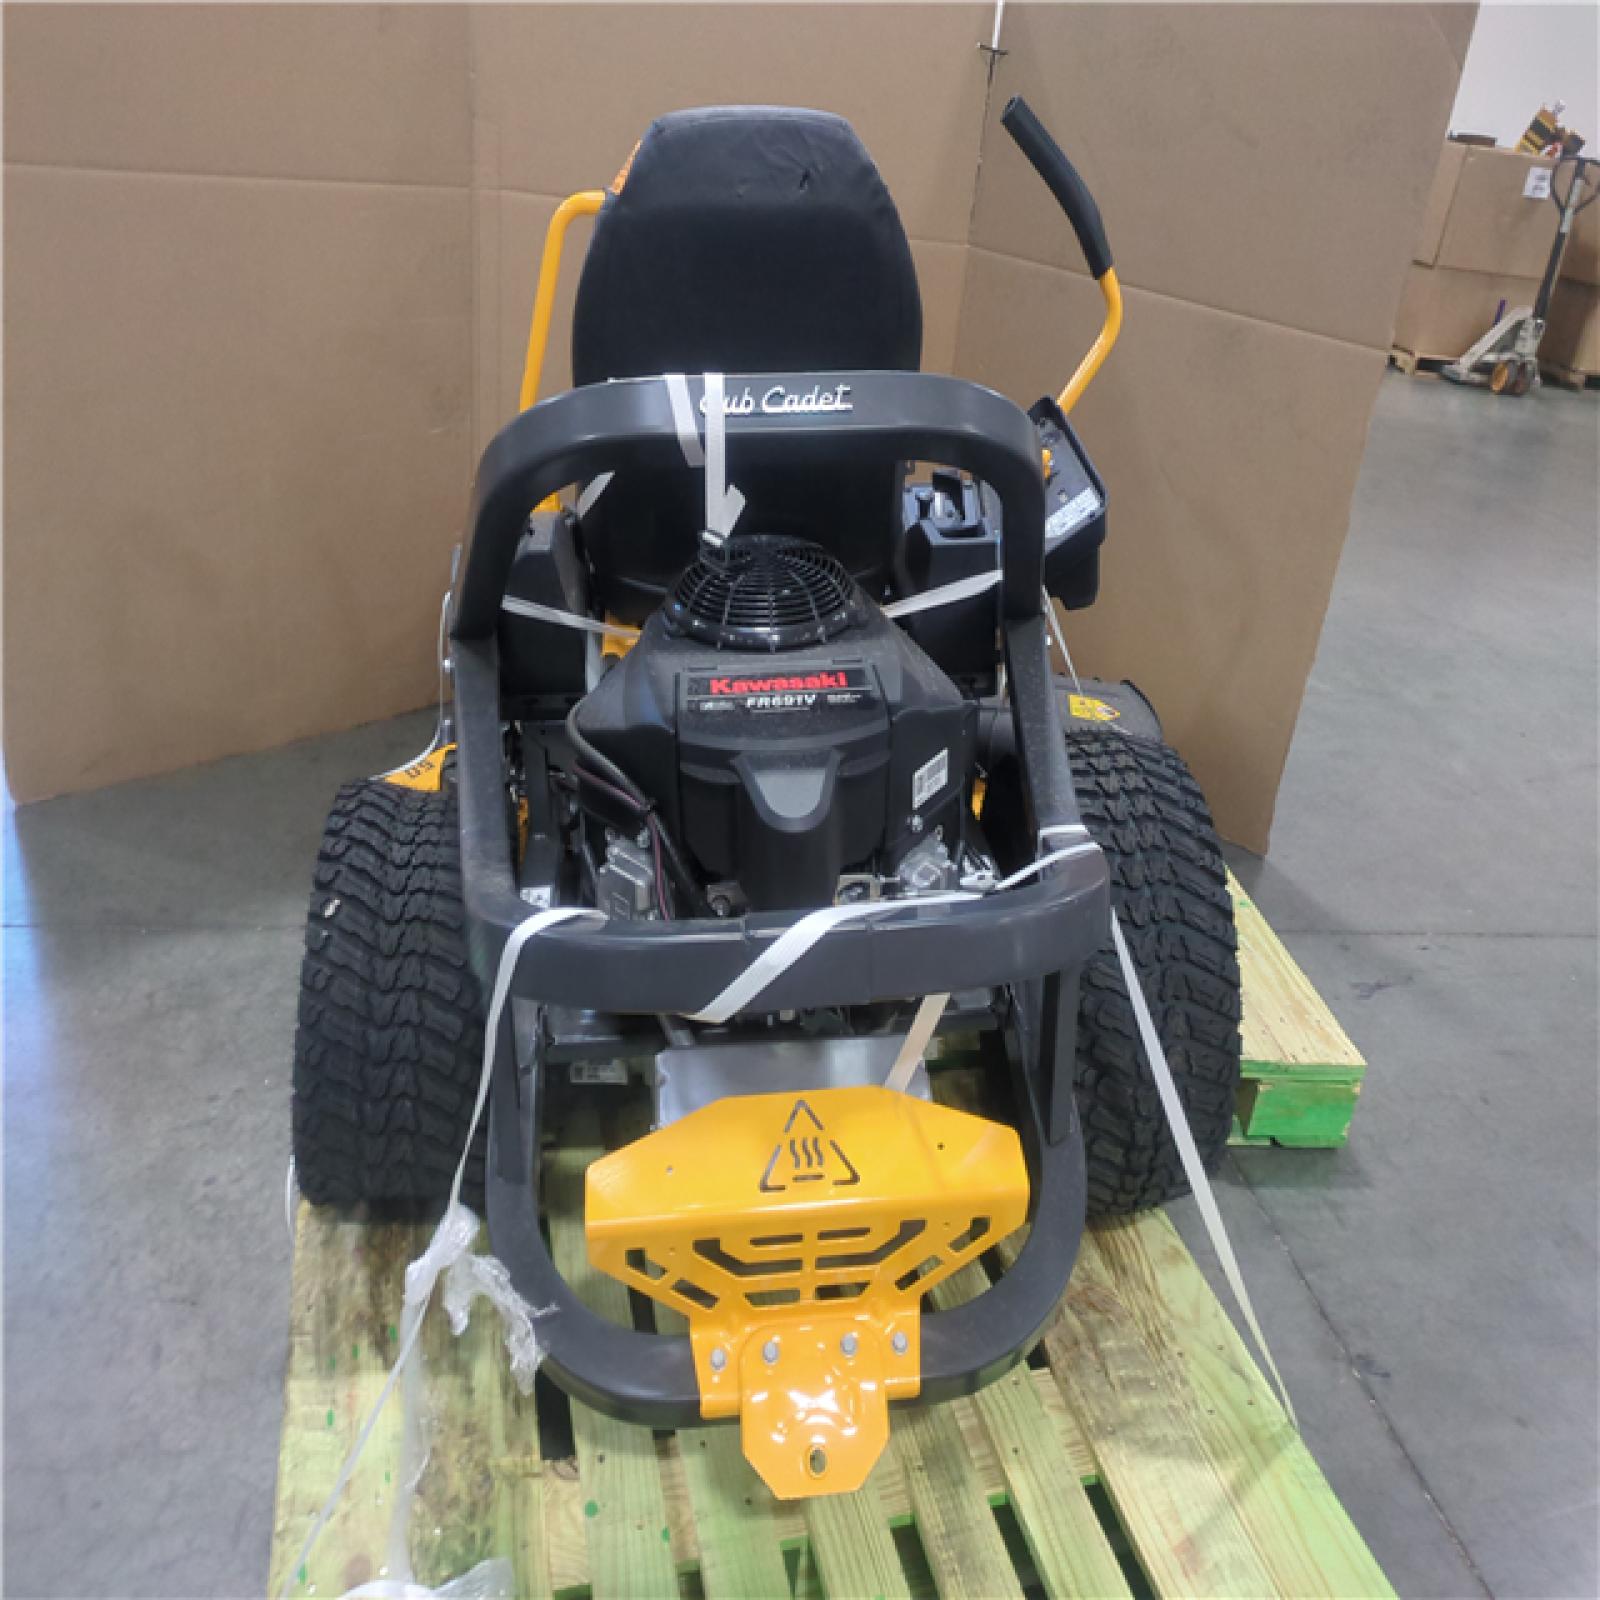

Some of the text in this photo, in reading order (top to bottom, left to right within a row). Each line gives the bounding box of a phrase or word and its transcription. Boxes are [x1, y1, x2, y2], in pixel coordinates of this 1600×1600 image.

[700, 382, 853, 413] ub Cadet
[709, 671, 848, 694] Kawasaki
